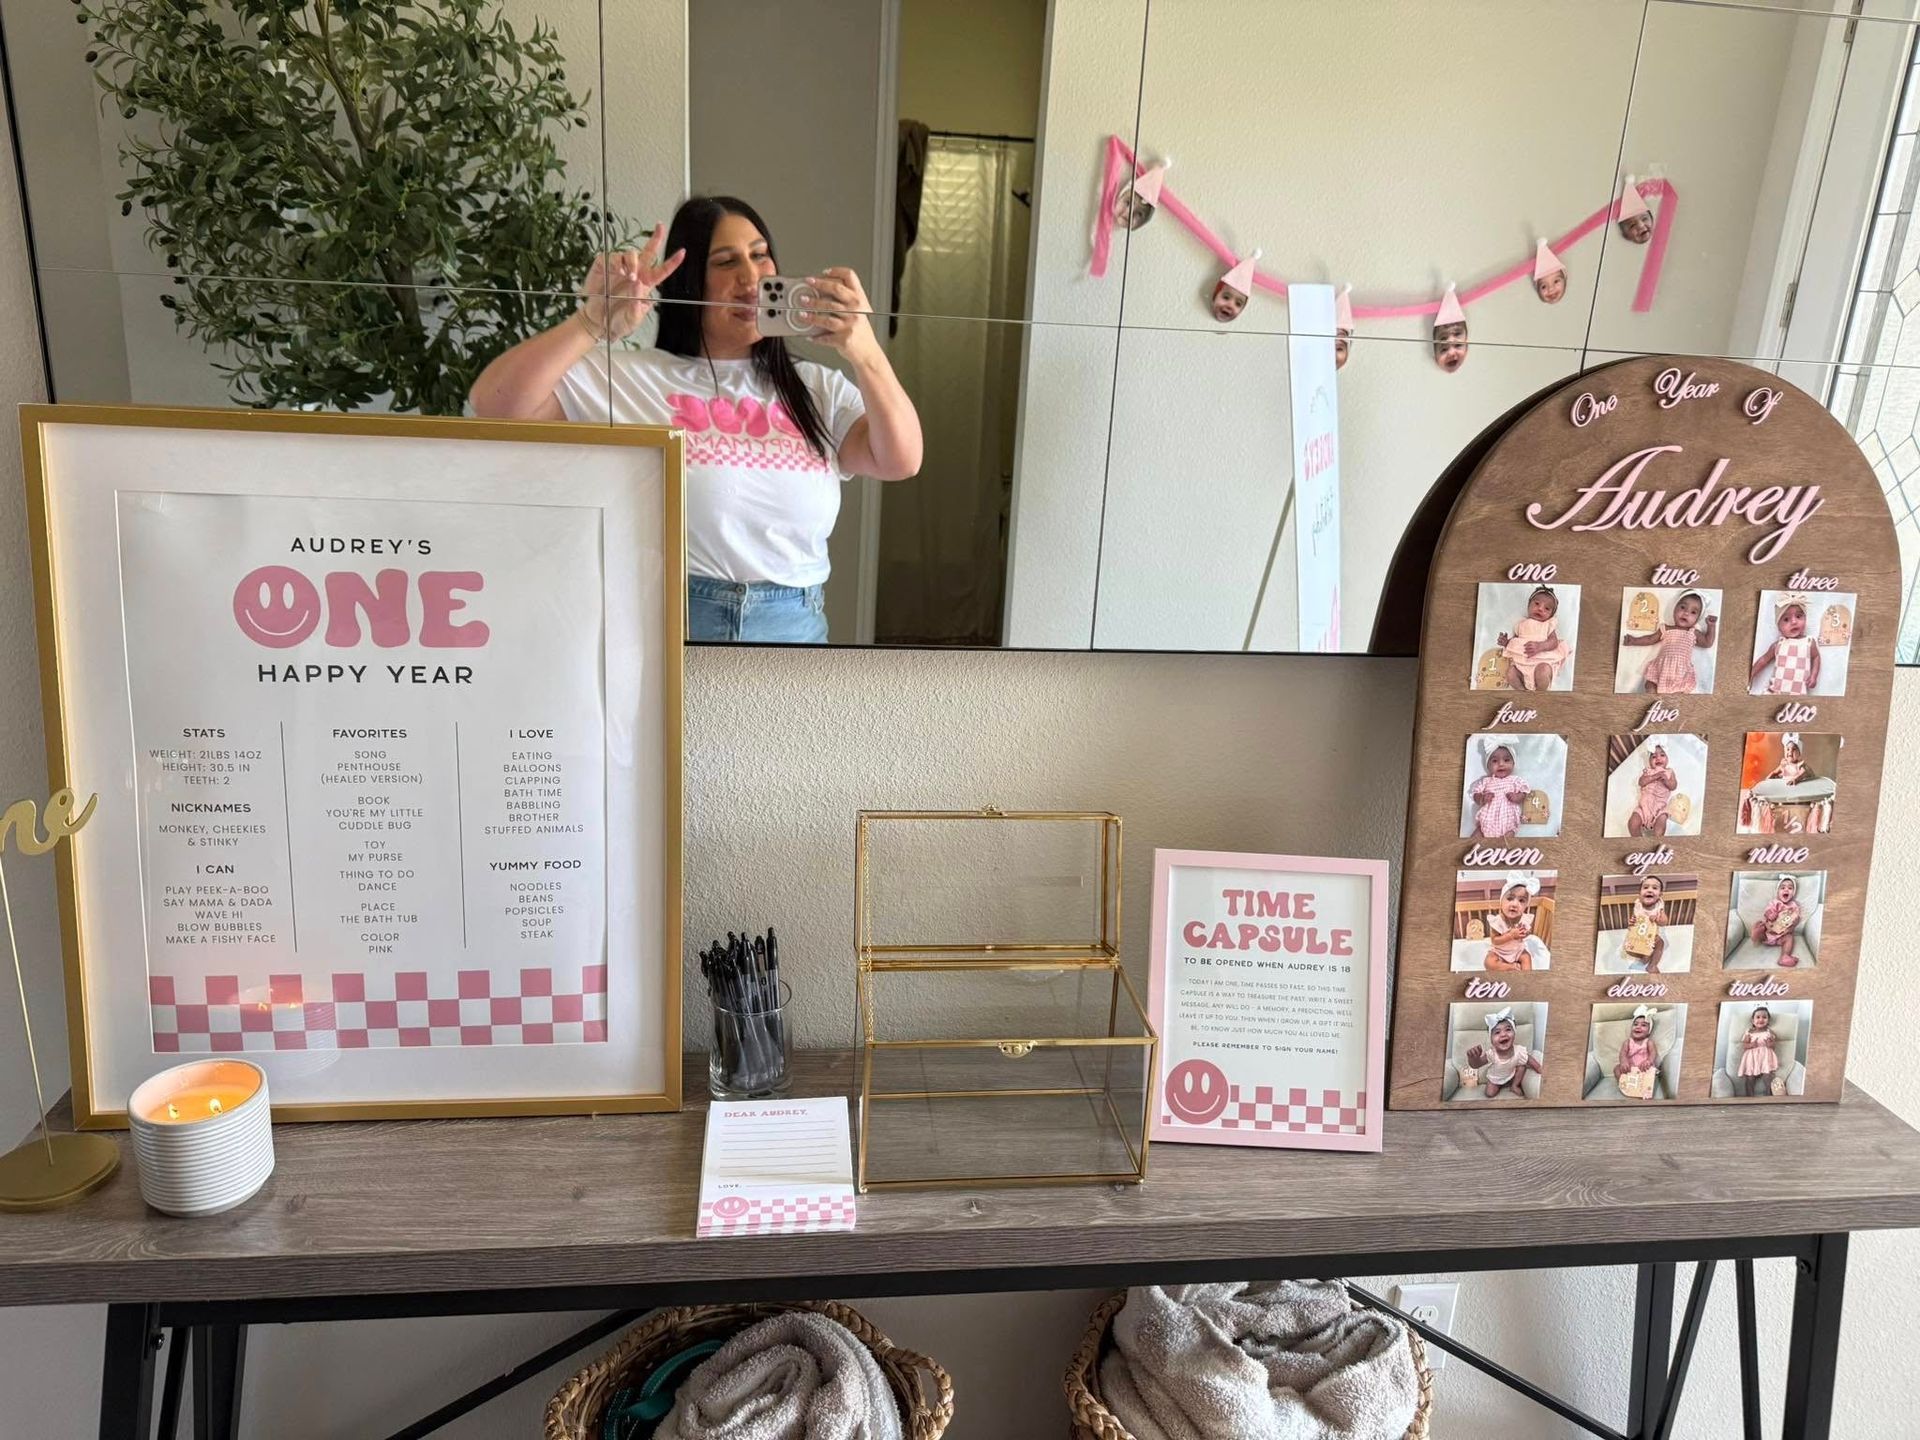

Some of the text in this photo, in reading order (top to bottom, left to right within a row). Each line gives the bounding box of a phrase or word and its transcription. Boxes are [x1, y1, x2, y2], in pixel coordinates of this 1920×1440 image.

[1568, 366, 1785, 429] One Year Of
[1524, 444, 1826, 567] Audrey
[290, 537, 432, 555] AUDREY'S
[1506, 560, 1840, 592] one two three
[233, 565, 490, 649] ONE
[1640, 600, 1649, 613] 2
[1831, 613, 1841, 627] 3
[1488, 657, 1497, 672] 1
[258, 664, 474, 684] HAPPY YEAR
[1481, 700, 1818, 732] four five six
[183, 728, 226, 738] STATS
[332, 729, 407, 739] FAVORITES
[518, 729, 554, 739] LOVE
[149, 749, 196, 759] WEIGHT:
[354, 750, 387, 759] SONG
[511, 751, 553, 760] EATING
[162, 762, 250, 772] HEIGHT: 30.5 IN
[337, 762, 401, 771] PENTHOUSE
[503, 764, 562, 773] BALLOONS
[183, 775, 230, 785] TEETH: 2
[320, 773, 423, 785] (HEALED VERSION)
[504, 776, 561, 785] CLAPPING
[504, 788, 562, 798] BATH TIME
[357, 796, 390, 805] BOOK
[506, 801, 561, 810] BABBLING
[171, 803, 252, 813] NICKNAMES
[326, 808, 424, 818] YOU'RE MY LITTLE
[509, 813, 559, 822] BROTHER
[159, 824, 266, 834] MONKEY, CHEEKIES
[338, 821, 412, 830] CUDDLE BUG
[484, 824, 584, 835] STUFFED ANIMALS
[187, 838, 239, 846] & STINKY
[364, 840, 386, 849] TOY
[348, 853, 403, 862] MY PURSE
[1463, 842, 1810, 876] seven eight nine
[205, 865, 235, 874] CAN
[489, 860, 582, 871] YUMMY FOOD
[339, 870, 415, 879] THING TO DO
[165, 886, 269, 894] PLAY PEEK-A-BOO
[358, 882, 397, 891] DANCE
[510, 882, 562, 892] NOODLES
[163, 898, 273, 907] SAY MAMA & DADA
[518, 894, 554, 903] BEANS
[360, 902, 396, 911] PLACE
[1222, 889, 1317, 920] TIME
[195, 911, 243, 919] WAVE HI
[504, 905, 564, 916] POPSICLES
[340, 914, 418, 924] THE BATH TUB
[521, 918, 552, 927] SOUP
[177, 923, 262, 932] BLOW BUBBLES
[165, 934, 276, 944] MAKE A FISHY FACE
[360, 932, 400, 942] COLOR
[520, 930, 554, 939] STEAK
[1183, 920, 1353, 956] CAPSULE
[368, 945, 393, 953] PINK
[1184, 957, 1196, 965] TO
[1216, 959, 1253, 968] OPENED
[1257, 961, 1284, 969] WHEN
[1287, 963, 1325, 972] AUDREY
[1464, 976, 1790, 1000] ten eleven twelve
[1221, 1042, 1259, 1050] REMEMBER
